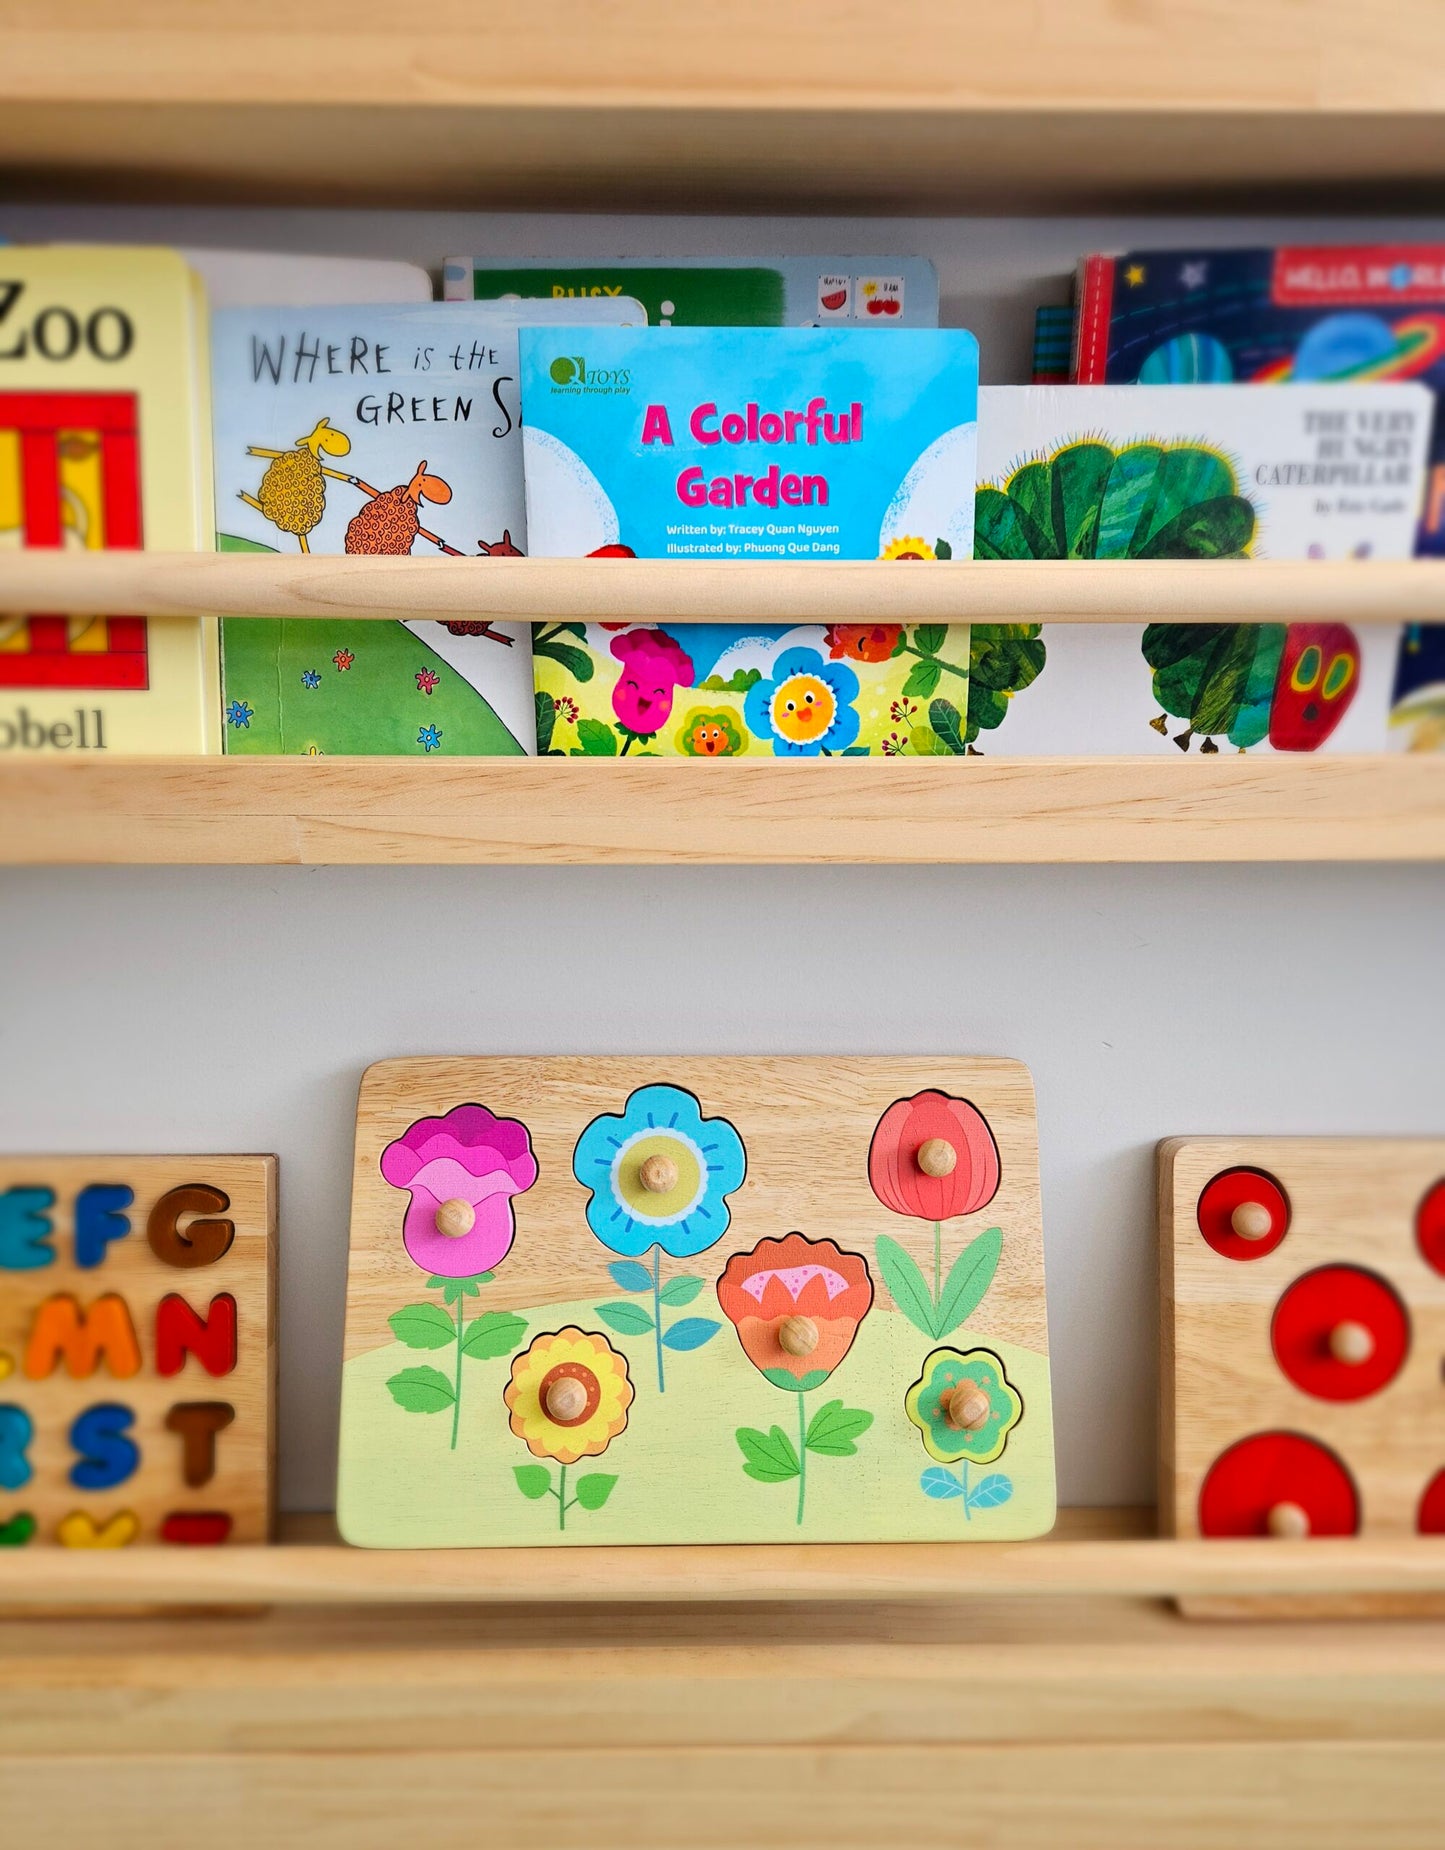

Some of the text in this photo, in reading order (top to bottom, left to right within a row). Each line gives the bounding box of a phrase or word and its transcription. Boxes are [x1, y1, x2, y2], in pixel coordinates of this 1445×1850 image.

[252, 331, 391, 385] WHERE
[356, 391, 473, 425] GREEN
[641, 398, 863, 445] A Colorful
[676, 464, 829, 509] Garden
[1255, 463, 1411, 485] CATERPILLAR
[666, 524, 839, 537] Written by: Tracey Quan Nguyen
[666, 542, 840, 555] Illustrated by: Phuong Que Dang
